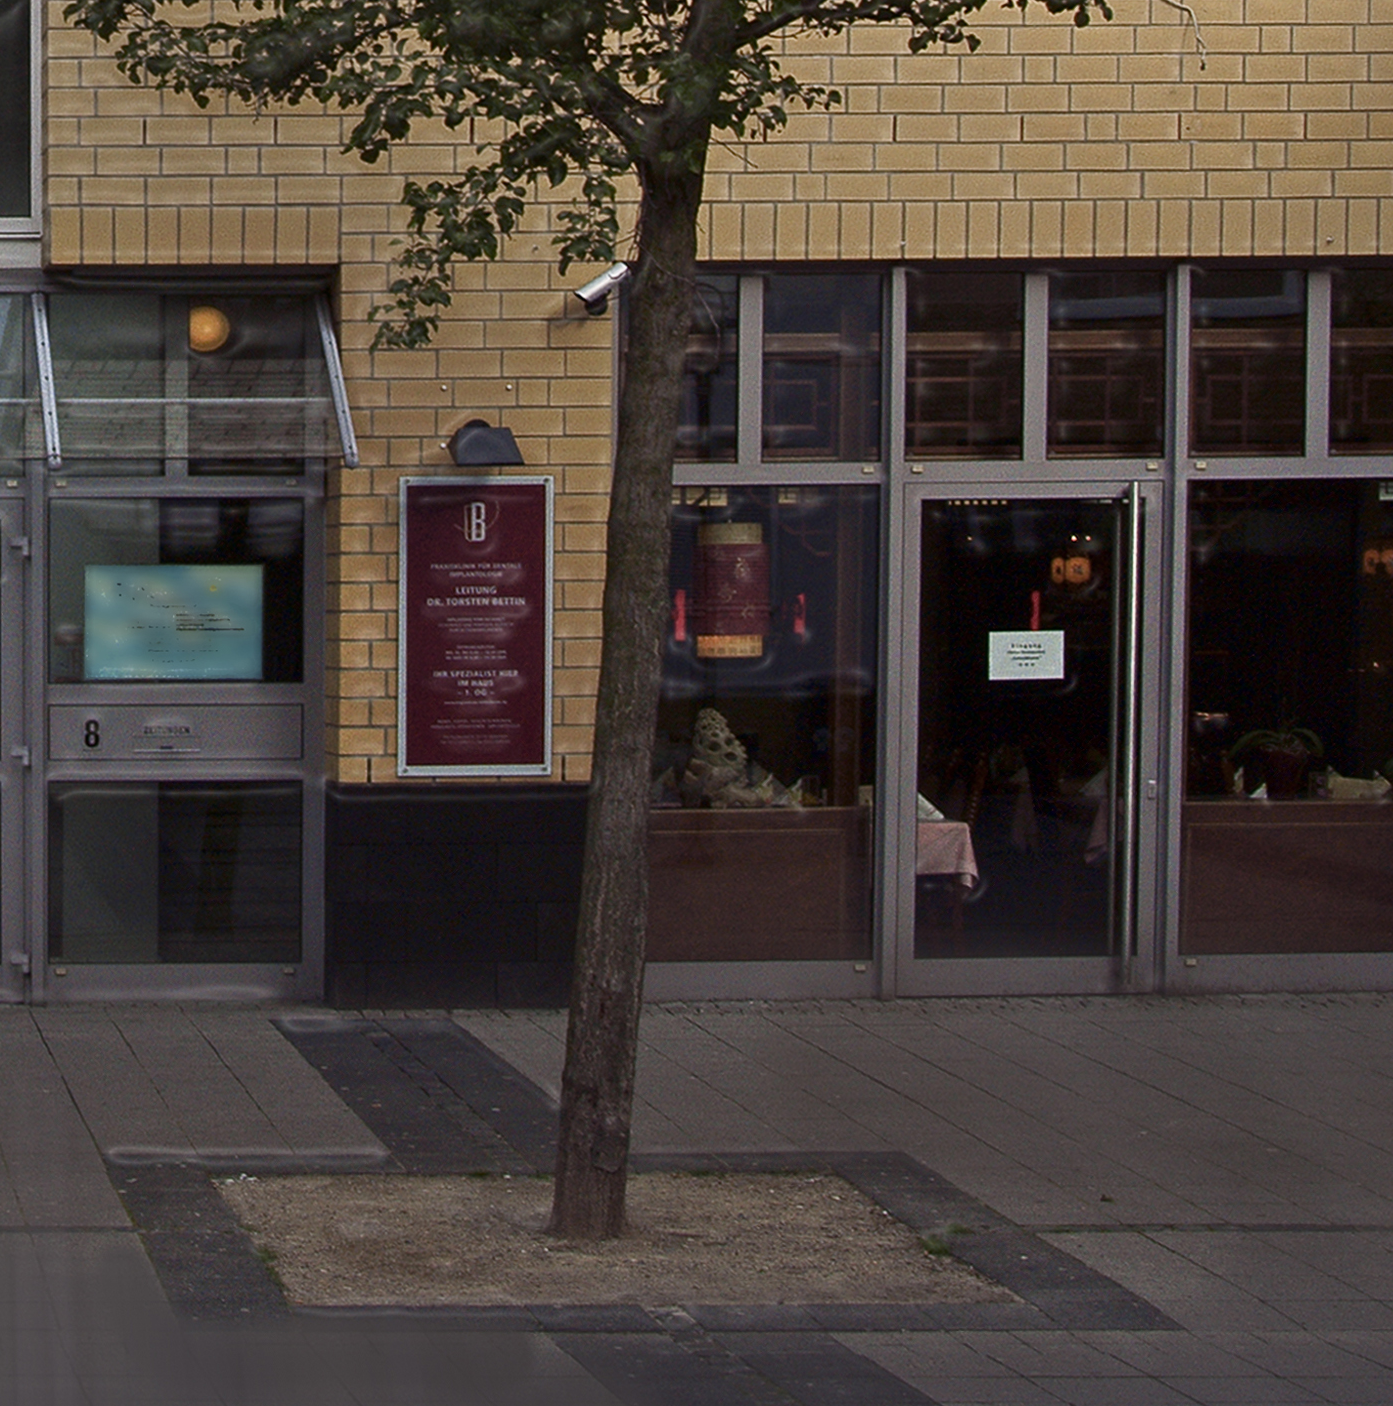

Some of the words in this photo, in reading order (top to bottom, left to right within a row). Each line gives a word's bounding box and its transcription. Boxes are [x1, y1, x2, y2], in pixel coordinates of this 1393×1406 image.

[455, 586, 497, 595] LEITUNG
[427, 597, 444, 606] DR.
[446, 597, 489, 606] TORSTEN
[450, 670, 496, 678] SPEZIALIST
[84, 719, 100, 748] 8
